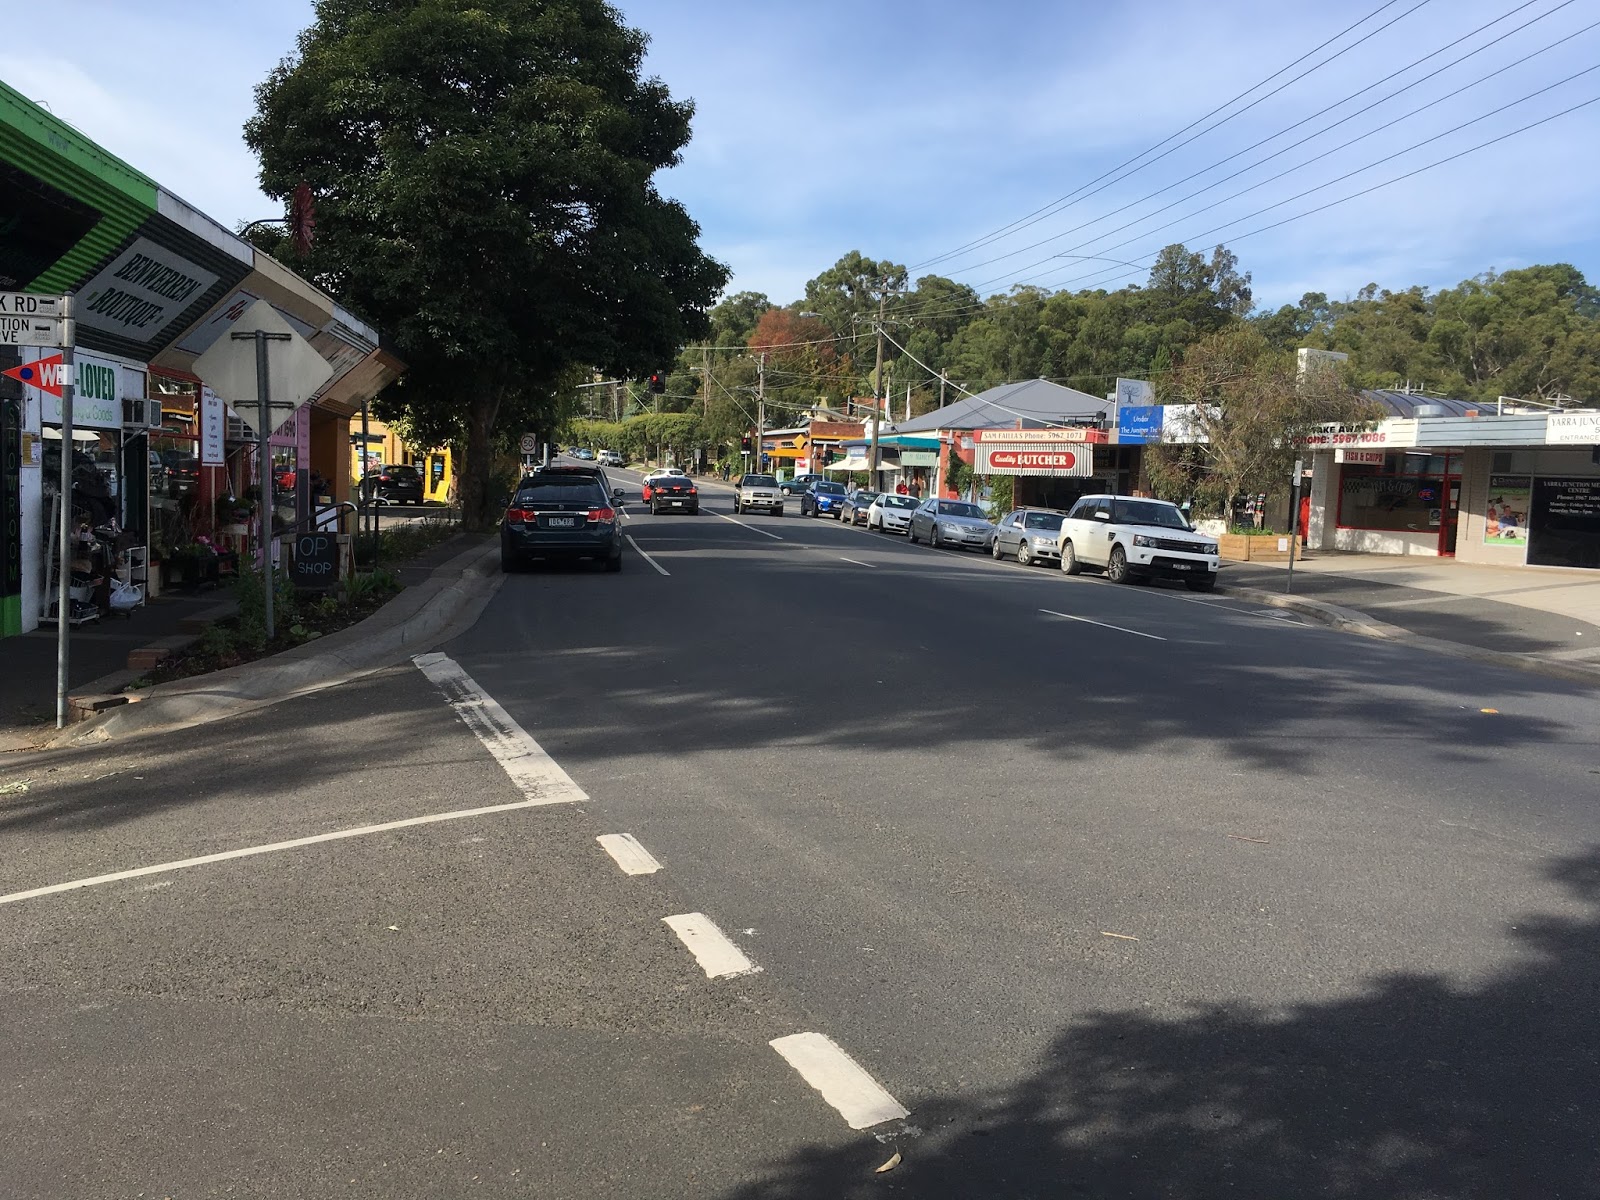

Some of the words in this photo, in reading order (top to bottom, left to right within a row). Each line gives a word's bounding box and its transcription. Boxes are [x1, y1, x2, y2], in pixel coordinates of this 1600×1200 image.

[114, 253, 202, 302] BENWERREN
[15, 296, 37, 312] RD
[86, 287, 164, 328] BOUTIQUE
[0, 318, 30, 331] TION
[0, 330, 19, 343] VE
[1551, 417, 1577, 426] YARRA
[984, 431, 997, 439] SAM
[1024, 431, 1046, 439] Phone:
[1066, 431, 1082, 439] 1071
[1332, 434, 1358, 444] 5967
[1360, 432, 1386, 443] 1086
[523, 439, 533, 448] 50
[994, 454, 1016, 465] Quality
[1017, 454, 1067, 465] BUTCHER
[1345, 452, 1358, 461] FISH
[1360, 452, 1364, 461] &
[1365, 453, 1382, 462] CHIPS
[300, 537, 328, 556] OP
[298, 562, 331, 574] SHOP
